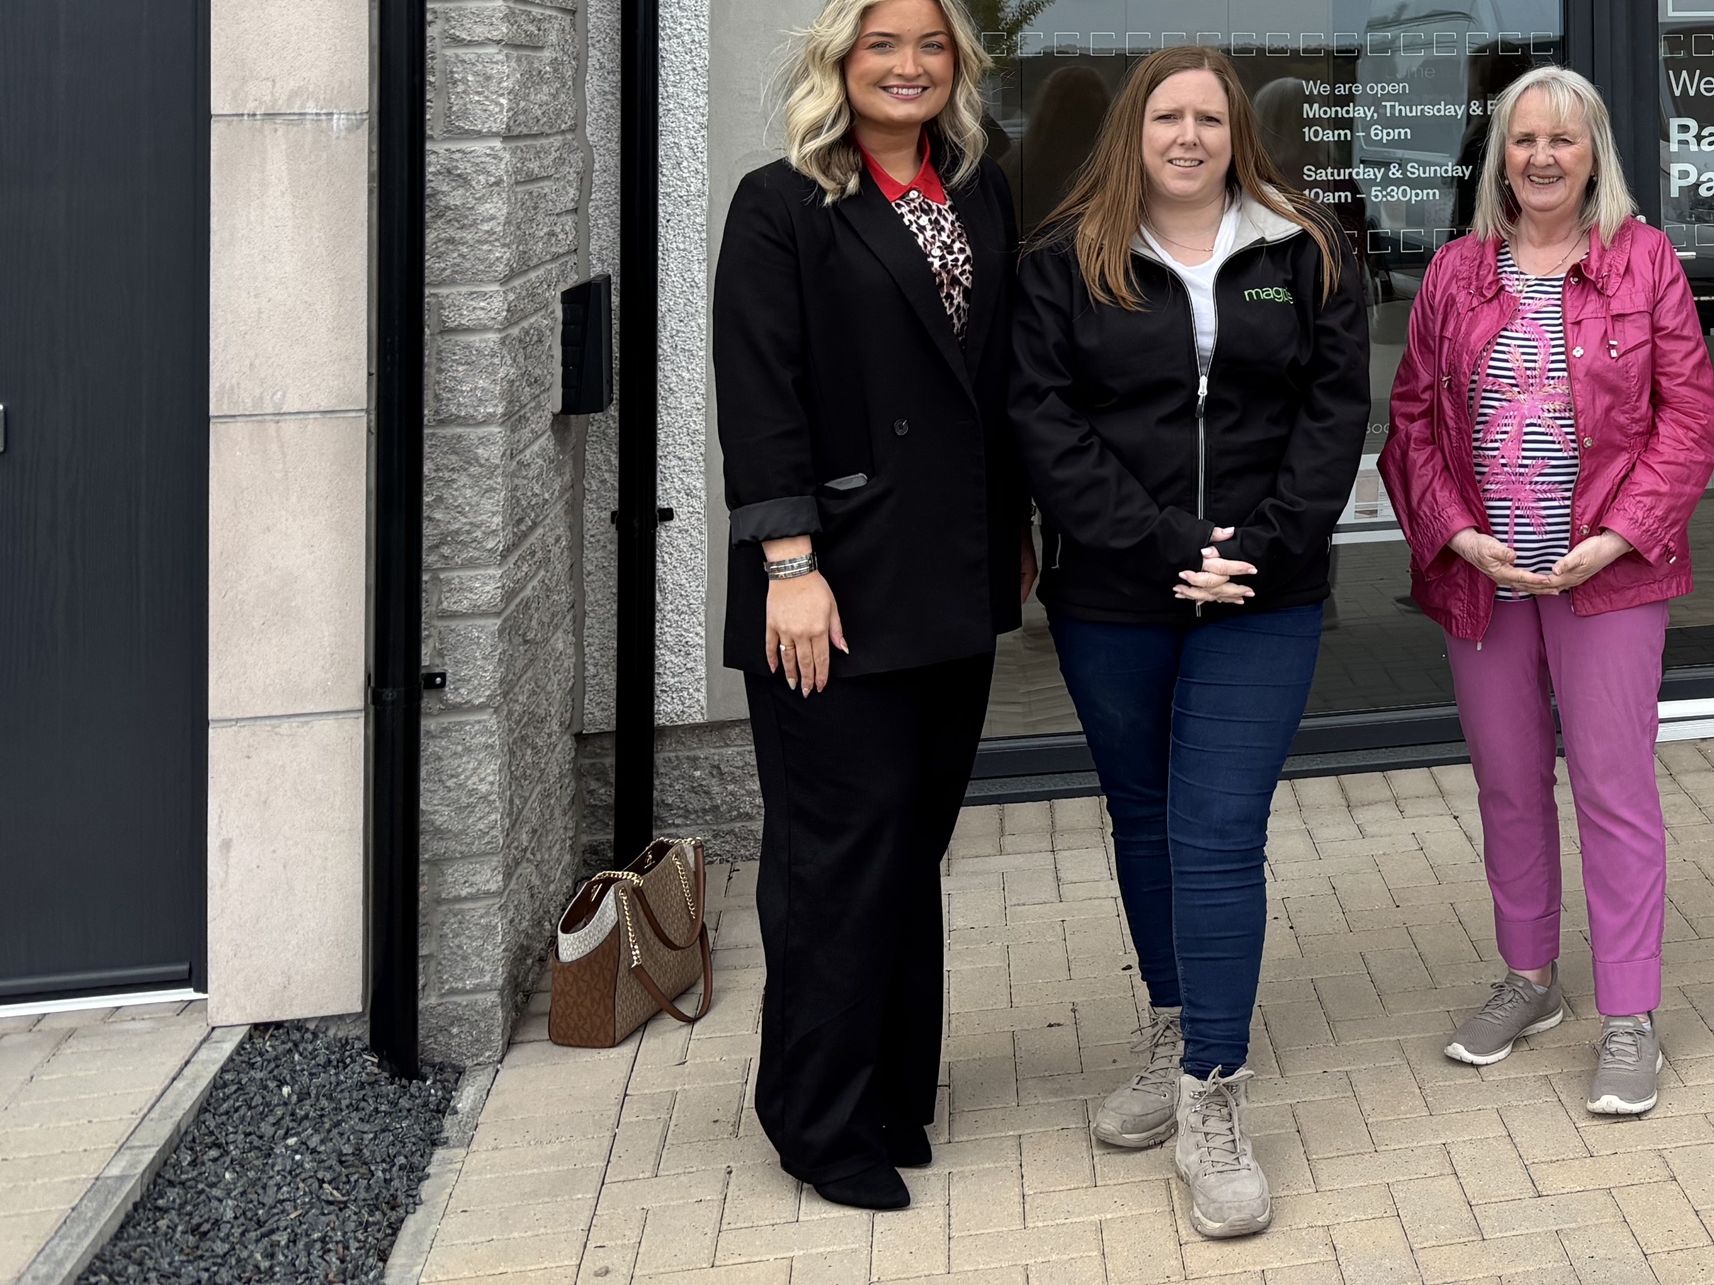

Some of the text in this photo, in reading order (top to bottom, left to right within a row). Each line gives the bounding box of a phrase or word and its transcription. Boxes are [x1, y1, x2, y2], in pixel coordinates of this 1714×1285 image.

[1302, 80, 1409, 97] We are open
[1302, 102, 1378, 120] Monday,
[1382, 100, 1466, 119] Thursday
[1469, 100, 1484, 115] &
[1302, 126, 1351, 142] 10am
[1370, 124, 1411, 143] 6pm
[1302, 162, 1473, 182] Saturday & Sunday
[1302, 187, 1352, 204] 10am
[1370, 185, 1440, 205] 5:30pm
